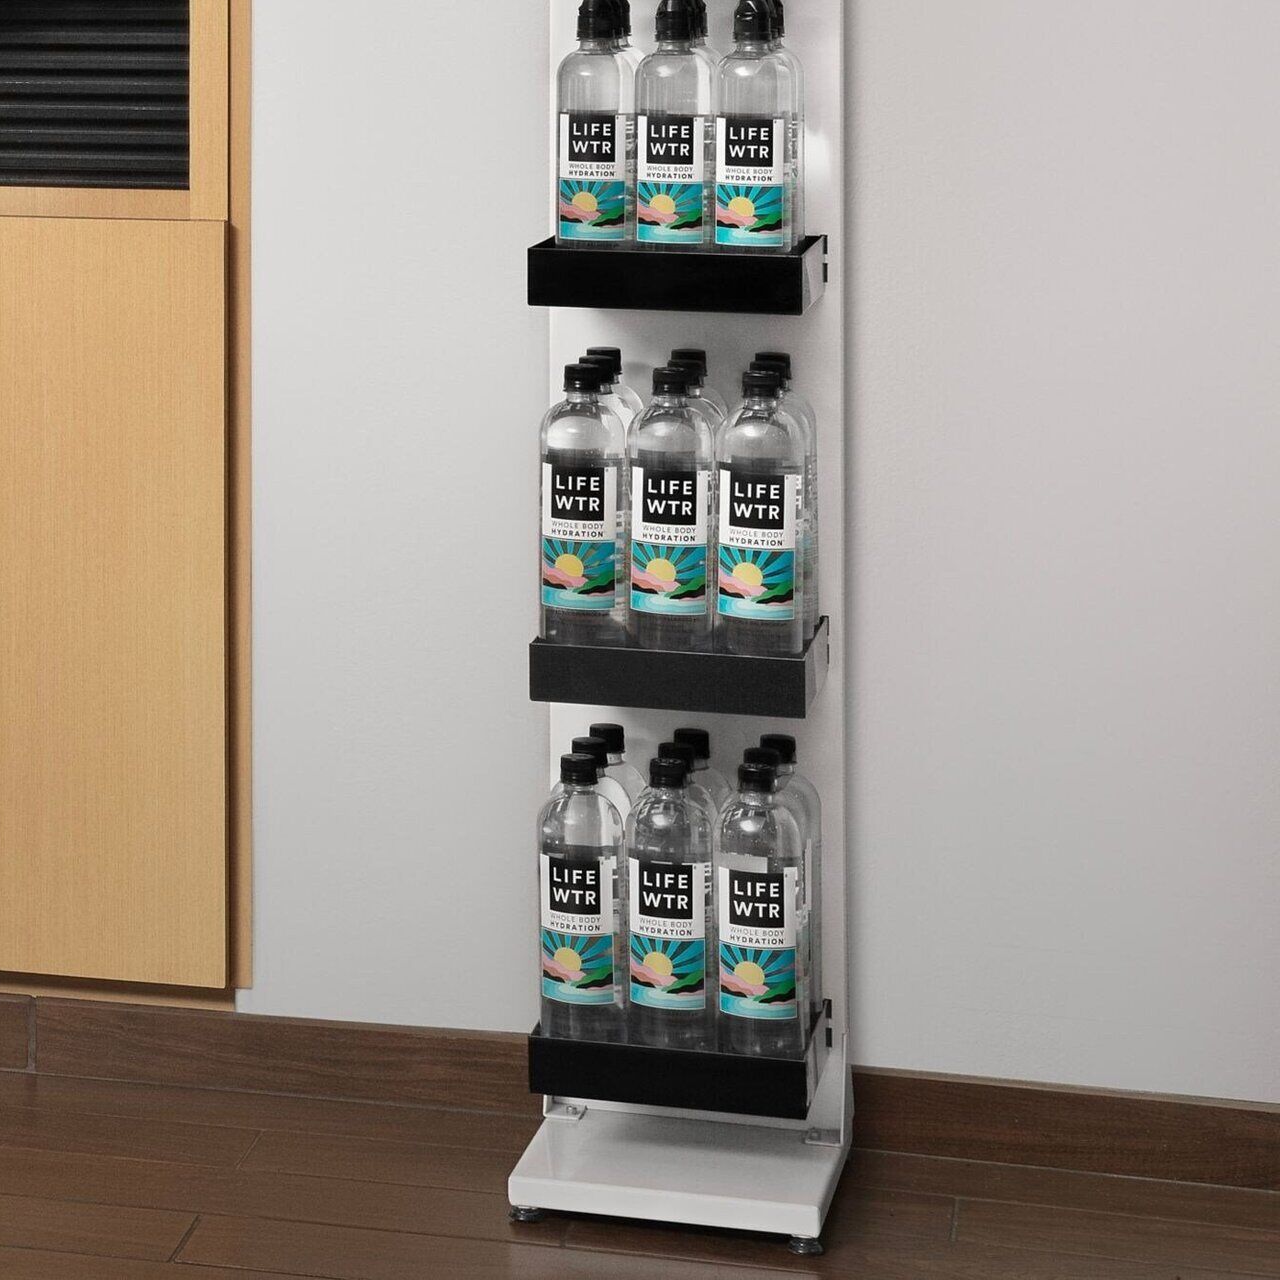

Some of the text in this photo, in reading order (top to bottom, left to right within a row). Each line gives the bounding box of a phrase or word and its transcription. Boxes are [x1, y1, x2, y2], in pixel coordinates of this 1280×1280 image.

[573, 123, 611, 136] LIFE
[651, 125, 690, 138] LIFE
[729, 127, 769, 141] LIFE
[573, 141, 611, 154] WTR
[651, 143, 690, 156] WTR
[729, 145, 769, 159] WTR
[556, 475, 600, 491] LIFE
[647, 478, 693, 495] LIFE
[735, 482, 780, 499] LIFE
[555, 495, 600, 511] WTR
[647, 498, 692, 516] WTR
[734, 503, 780, 520] WTR
[551, 529, 603, 537] HYDRATION
[643, 533, 696, 542] HYDRATION
[730, 537, 783, 546] HYDRATION
[553, 866, 596, 885] LIFE
[643, 871, 688, 889] LIFE
[734, 880, 779, 897] LIFE
[553, 887, 596, 905] WTR
[643, 891, 688, 909] WTR
[734, 900, 779, 918] WTR
[550, 913, 576, 922] WHOLE
[550, 920, 601, 931] HYDRATION
[640, 926, 693, 936] HYDRATION
[730, 934, 784, 945] HYDRATION
